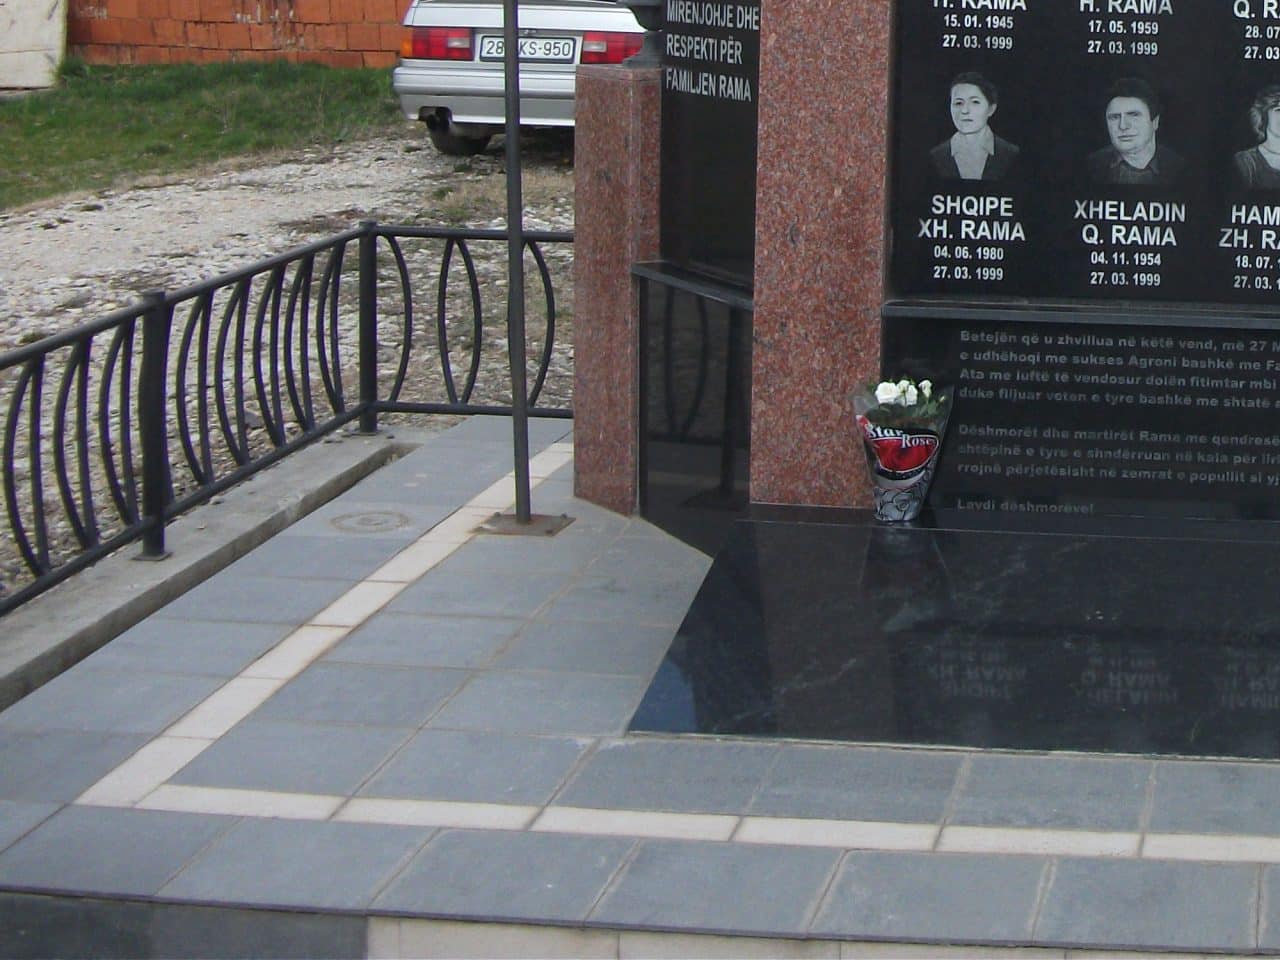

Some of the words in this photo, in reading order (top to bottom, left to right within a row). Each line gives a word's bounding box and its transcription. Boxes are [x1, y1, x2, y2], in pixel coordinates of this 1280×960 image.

[737, 6, 759, 30] DHE
[944, 14, 960, 27] 15.
[965, 15, 981, 27] 01.
[986, 16, 1013, 28] 1945
[1089, 20, 1105, 32] 17.
[1109, 21, 1126, 33] 05.
[1131, 22, 1158, 34] 1959
[1246, 25, 1262, 38] 28.
[667, 34, 717, 61] RESPEKTI
[720, 36, 742, 64] PËR
[943, 35, 960, 47] 27.
[964, 35, 980, 48] 03.
[985, 36, 1012, 49] 1999
[1088, 41, 1104, 53] 27.
[1109, 41, 1125, 53] 03.
[1131, 42, 1157, 55] 1999
[1245, 46, 1262, 59] 27.
[667, 68, 716, 96] FAMILJEN
[720, 75, 751, 101] RAMA
[932, 195, 1012, 216] SHQIPE
[1075, 200, 1185, 221] XHELADIN
[919, 219, 953, 238] XH.
[961, 220, 1025, 240] RAMA
[1083, 224, 1103, 244] Q.
[1112, 225, 1176, 245] RAMA
[1219, 229, 1253, 248] ZH.
[934, 246, 951, 258] 04.
[955, 246, 972, 258] 06.
[977, 247, 1003, 260] 1980
[1091, 252, 1108, 264] 04.
[1113, 252, 1129, 264] 11.
[1134, 253, 1161, 265] 1954
[1236, 256, 1251, 268] 18.
[1256, 256, 1273, 269] 07.
[934, 266, 950, 278] 27.
[955, 267, 971, 279] 03.
[976, 268, 1003, 280] 1999
[1091, 272, 1107, 284] 27.
[1112, 272, 1128, 285] 03.
[1133, 273, 1160, 285] 1999
[1234, 276, 1250, 288] 27.
[1255, 277, 1271, 289] 03.
